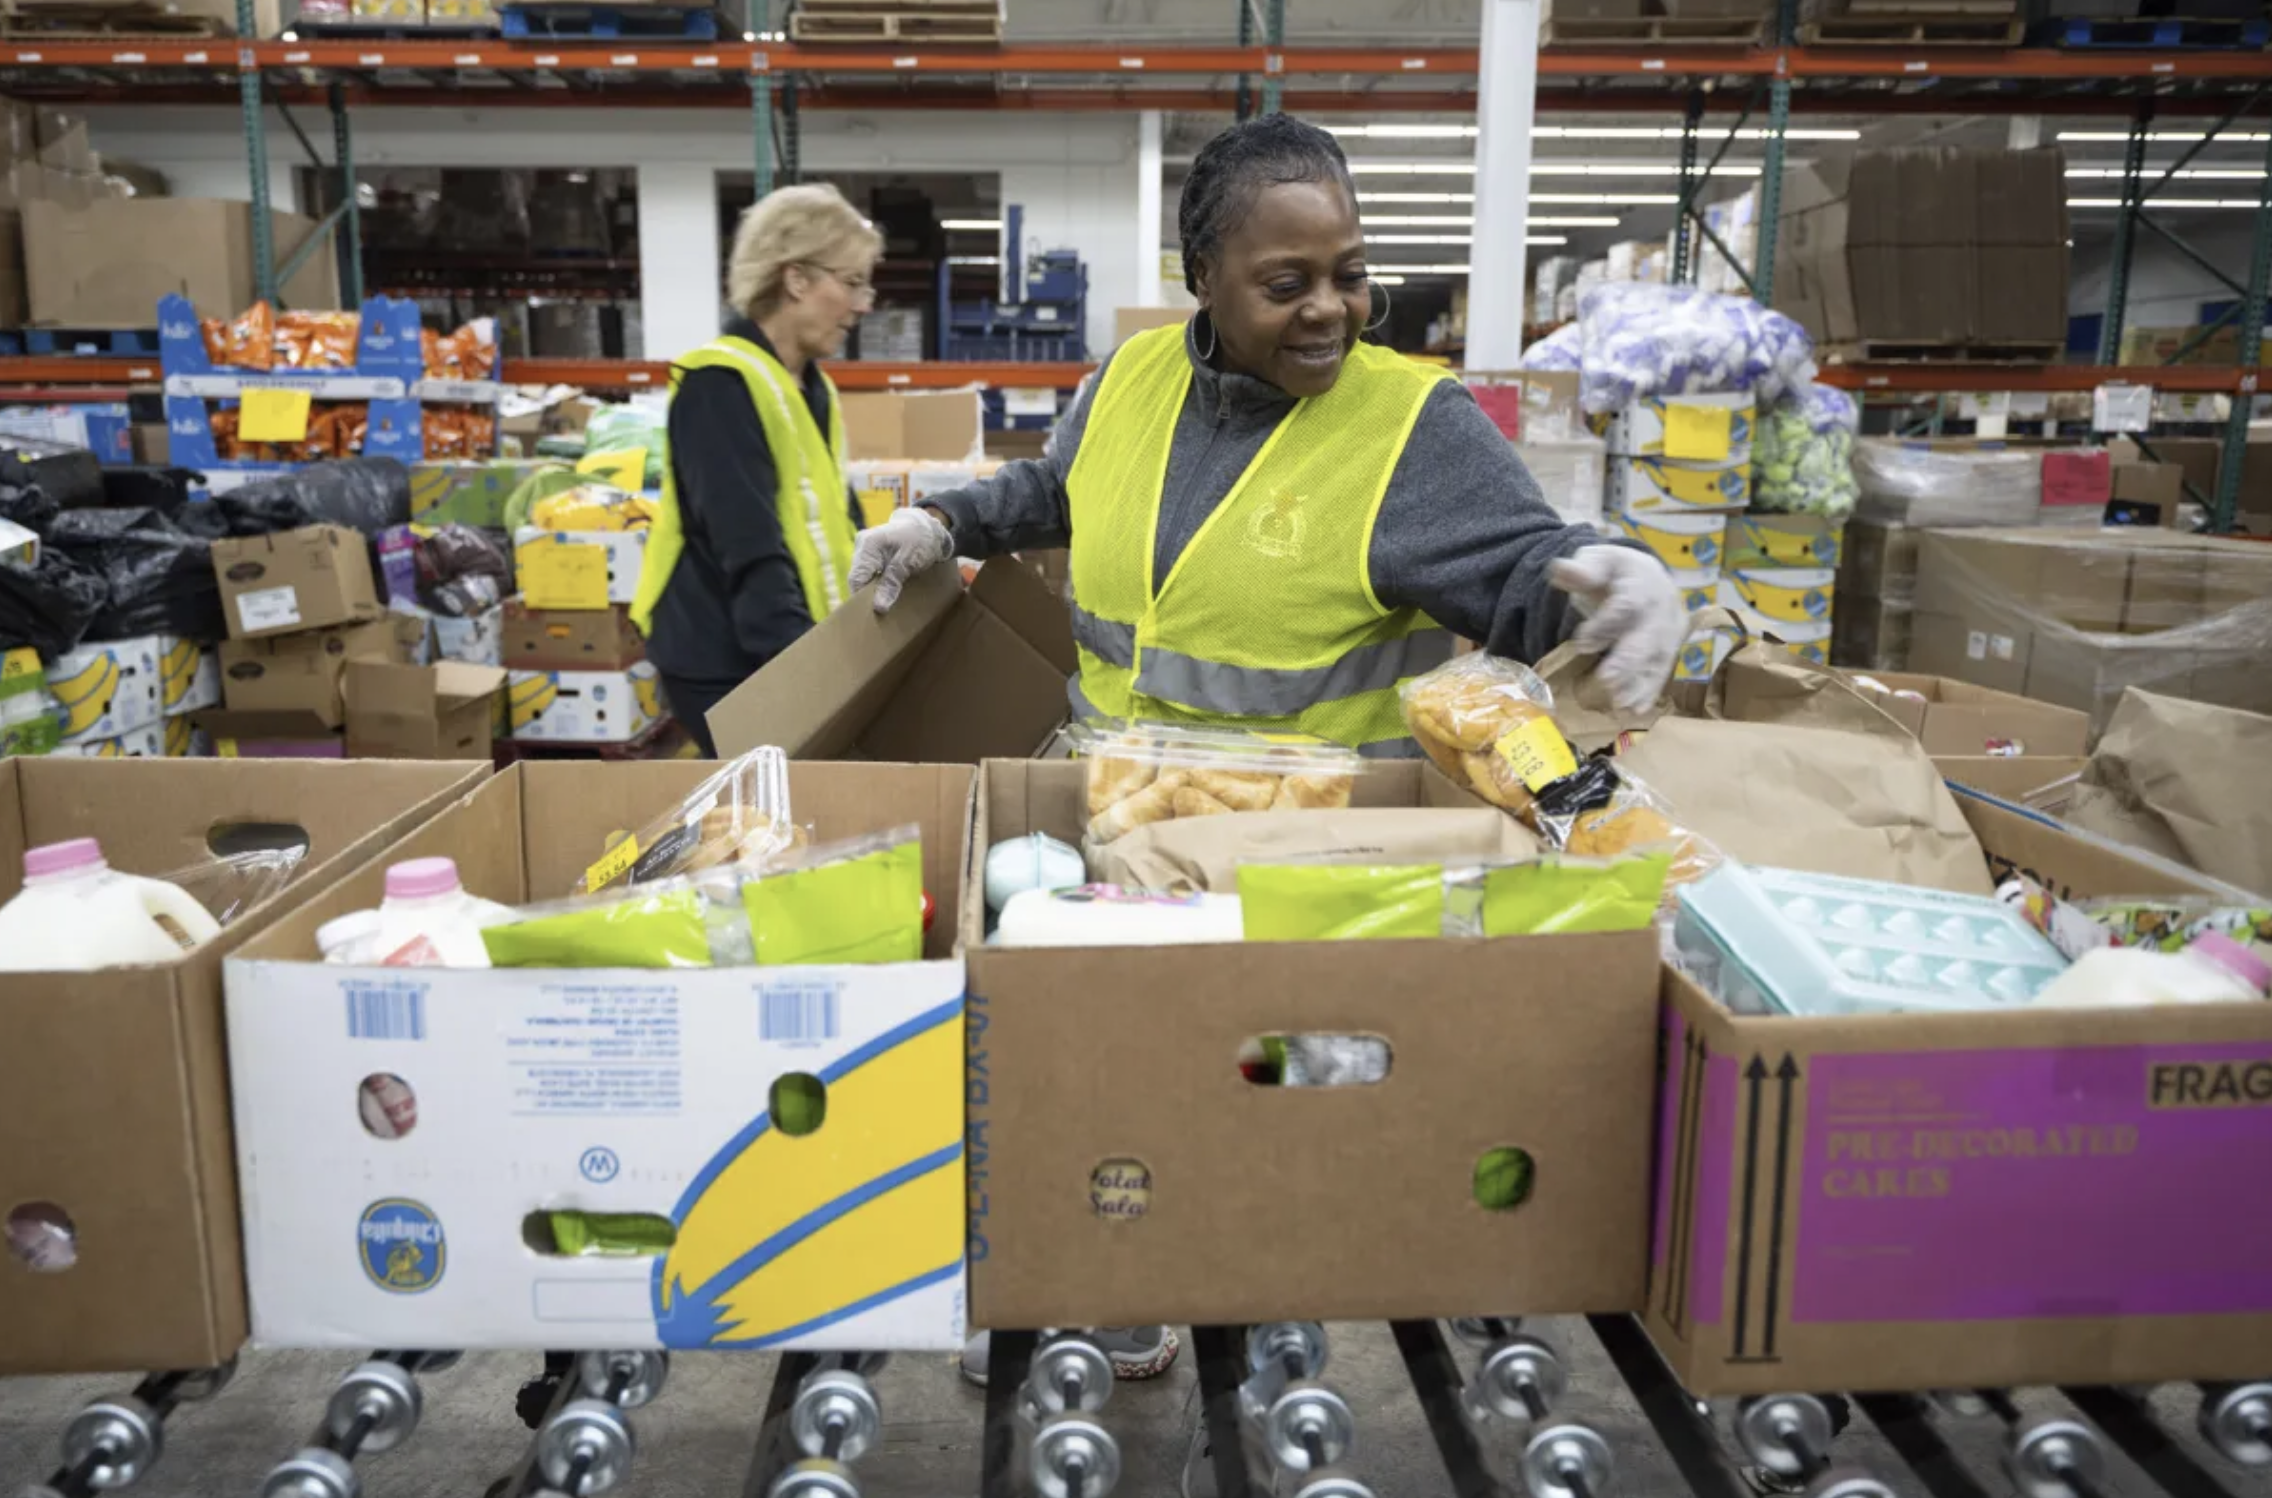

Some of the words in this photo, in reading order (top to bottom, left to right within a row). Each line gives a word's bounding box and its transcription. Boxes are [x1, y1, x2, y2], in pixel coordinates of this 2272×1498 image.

[2152, 1062, 2272, 1105] FRAG
[1828, 1124, 2140, 1161] PRE-DECORATED
[1821, 1166, 1952, 1198] CAKES
